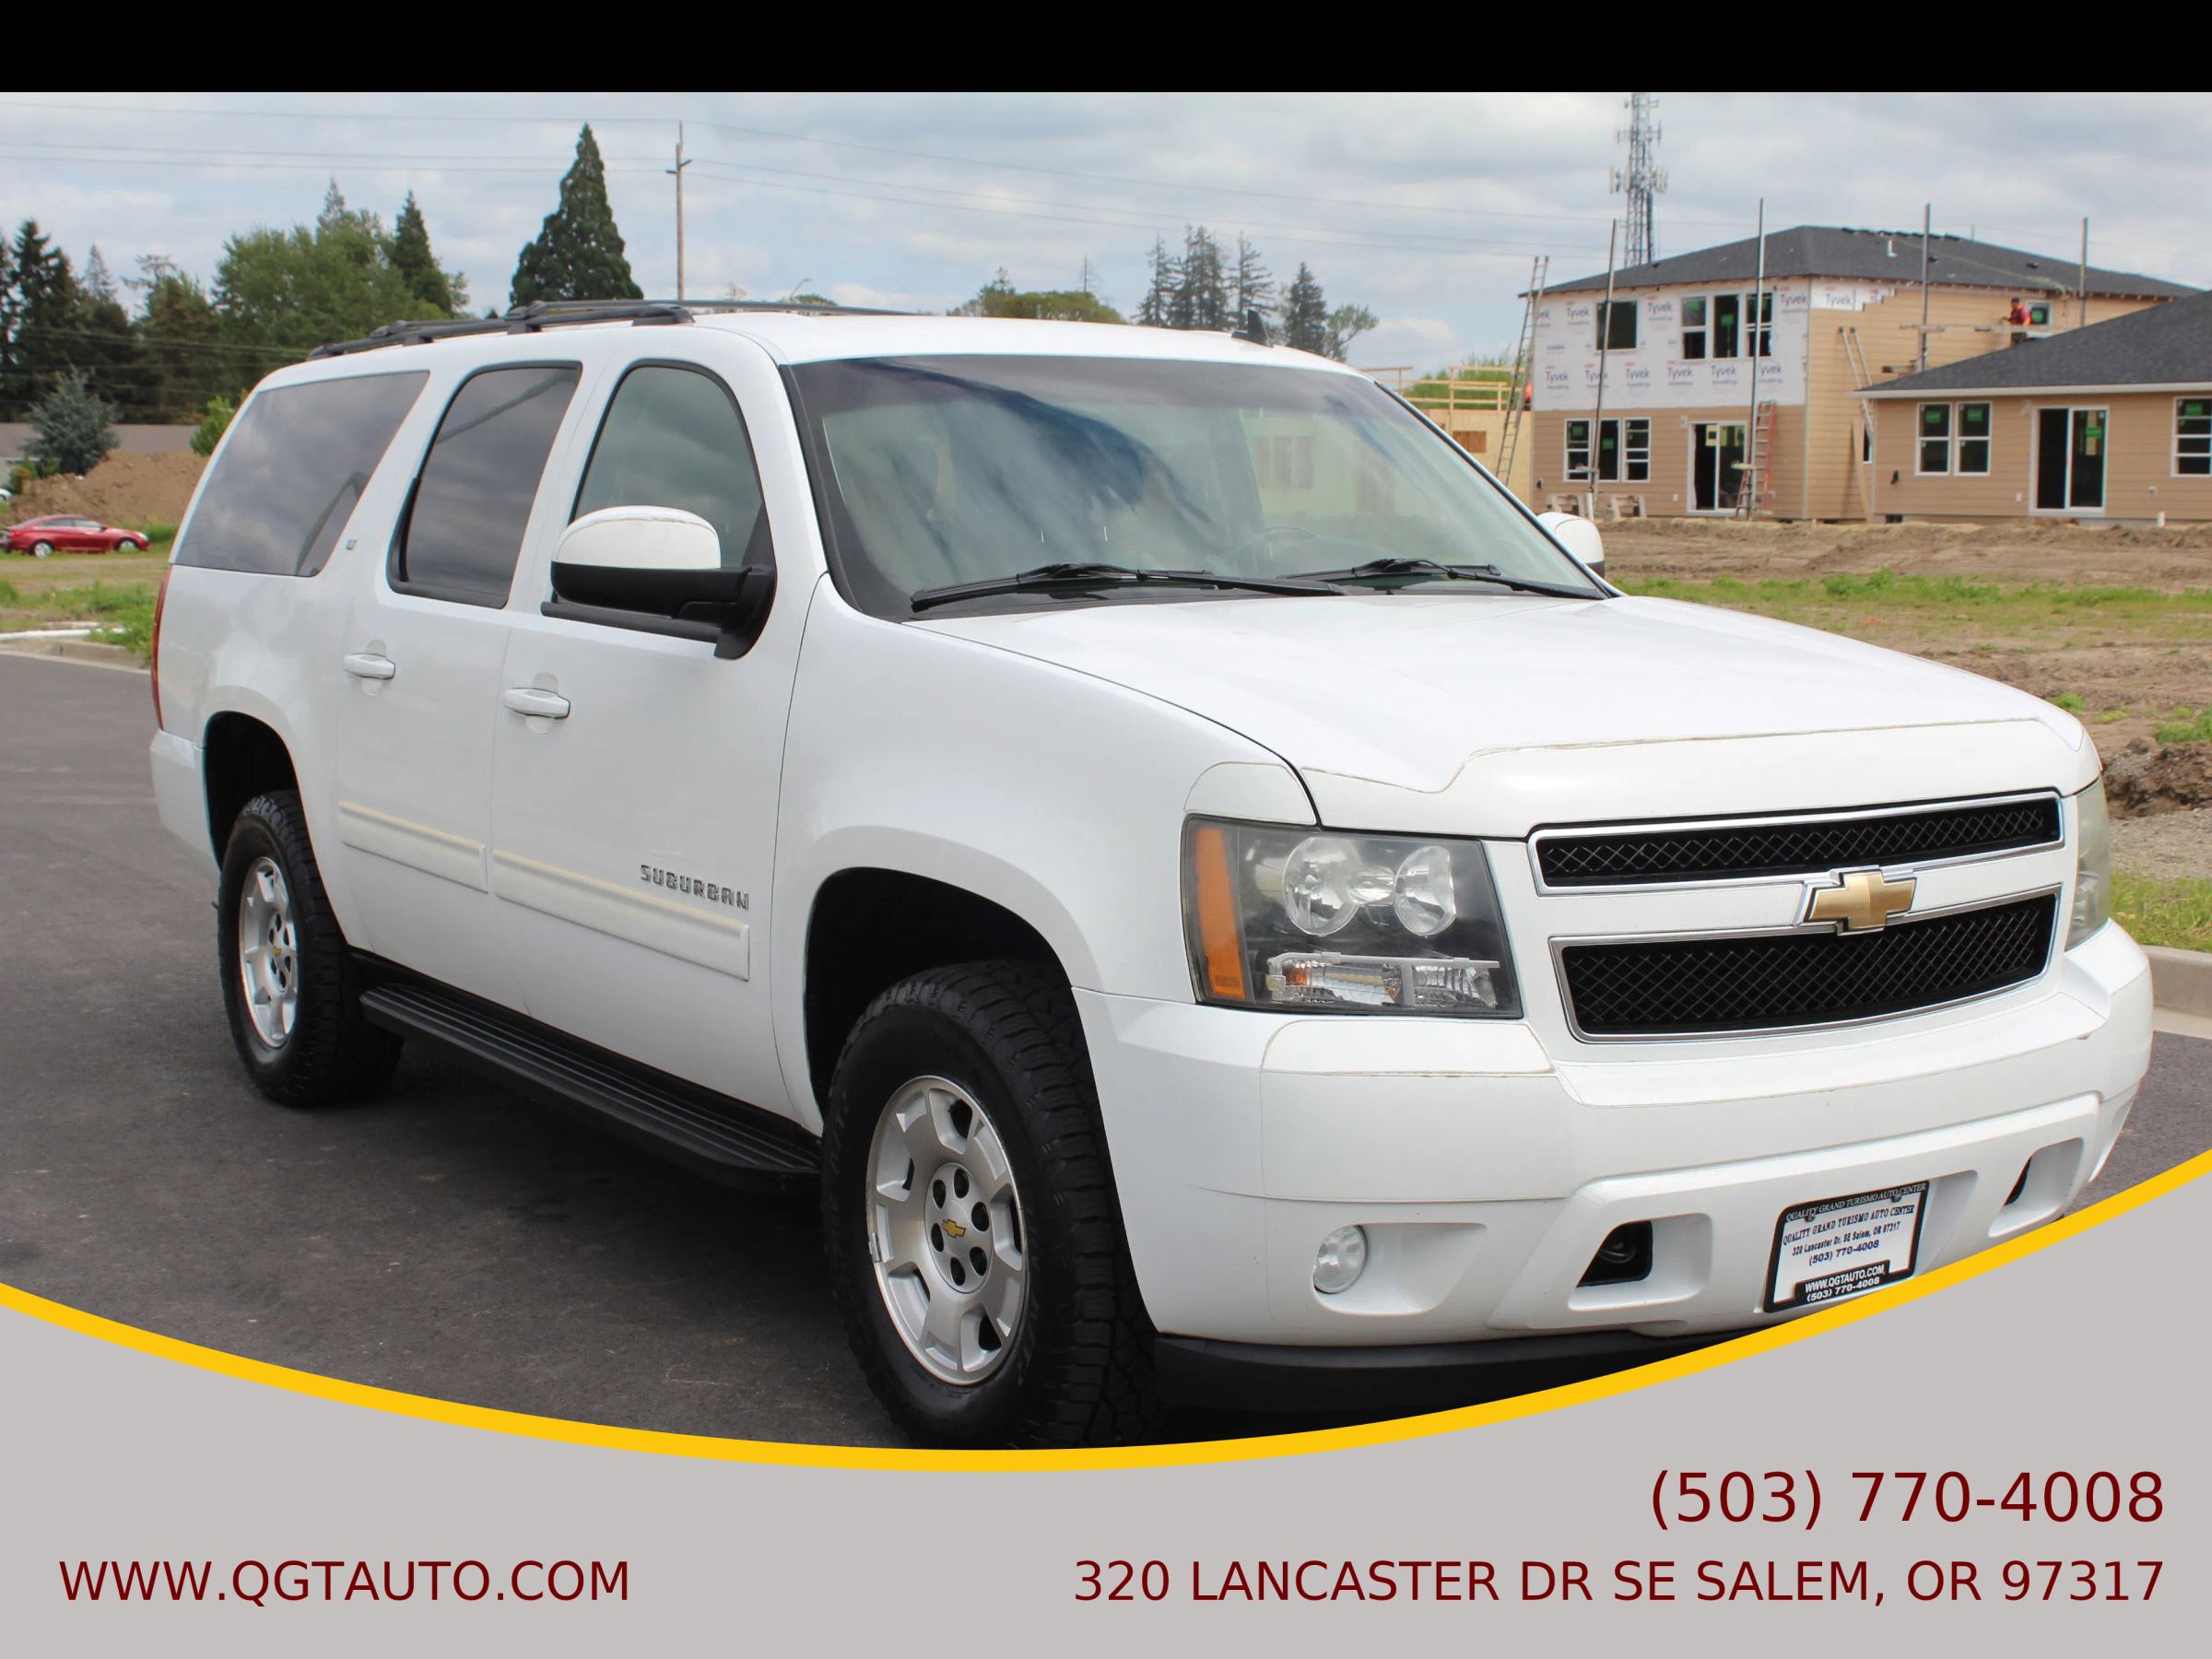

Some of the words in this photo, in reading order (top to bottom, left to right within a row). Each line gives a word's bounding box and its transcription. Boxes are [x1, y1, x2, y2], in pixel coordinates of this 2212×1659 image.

[1647, 300, 1672, 316] Tyvek
[1781, 292, 1806, 306] Tyvek
[1566, 306, 1589, 320] Tyvek
[1546, 371, 1569, 383] Tyvek
[1626, 368, 1650, 382] Tyvek
[1667, 366, 1692, 380] Tyvek
[1712, 363, 1736, 378] Tyvek
[641, 865, 749, 911] SUBURBAN
[1785, 1206, 1818, 1222] QUALITY
[1818, 1201, 1846, 1214] GRAND
[1846, 1194, 1878, 1207] TURISMO
[1878, 1189, 1899, 1201] AUTO
[1899, 1183, 1926, 1195] CENTER
[1783, 1228, 1811, 1245] QUALITY
[1812, 1220, 1836, 1235] GRAND
[1838, 1212, 1869, 1228] TURISMO
[1870, 1207, 1889, 1220] AUTO
[1889, 1205, 1915, 1217] CENTER
[1792, 1244, 1803, 1256] 320
[1804, 1238, 1832, 1253] Lancaster
[1833, 1236, 1842, 1245] Dr.
[1843, 1232, 1852, 1242] SE
[1852, 1228, 1871, 1241] Salem,
[1873, 1225, 1881, 1235] OR
[1882, 1220, 1900, 1233] 97317
[1808, 1249, 1833, 1267] (503)
[1835, 1239, 1879, 1258] 770-4008
[1805, 1264, 1885, 1293] WWW.QGTAUTO.COM
[1806, 1288, 1832, 1302] (503)
[1834, 1276, 1880, 1295] 770-4008
